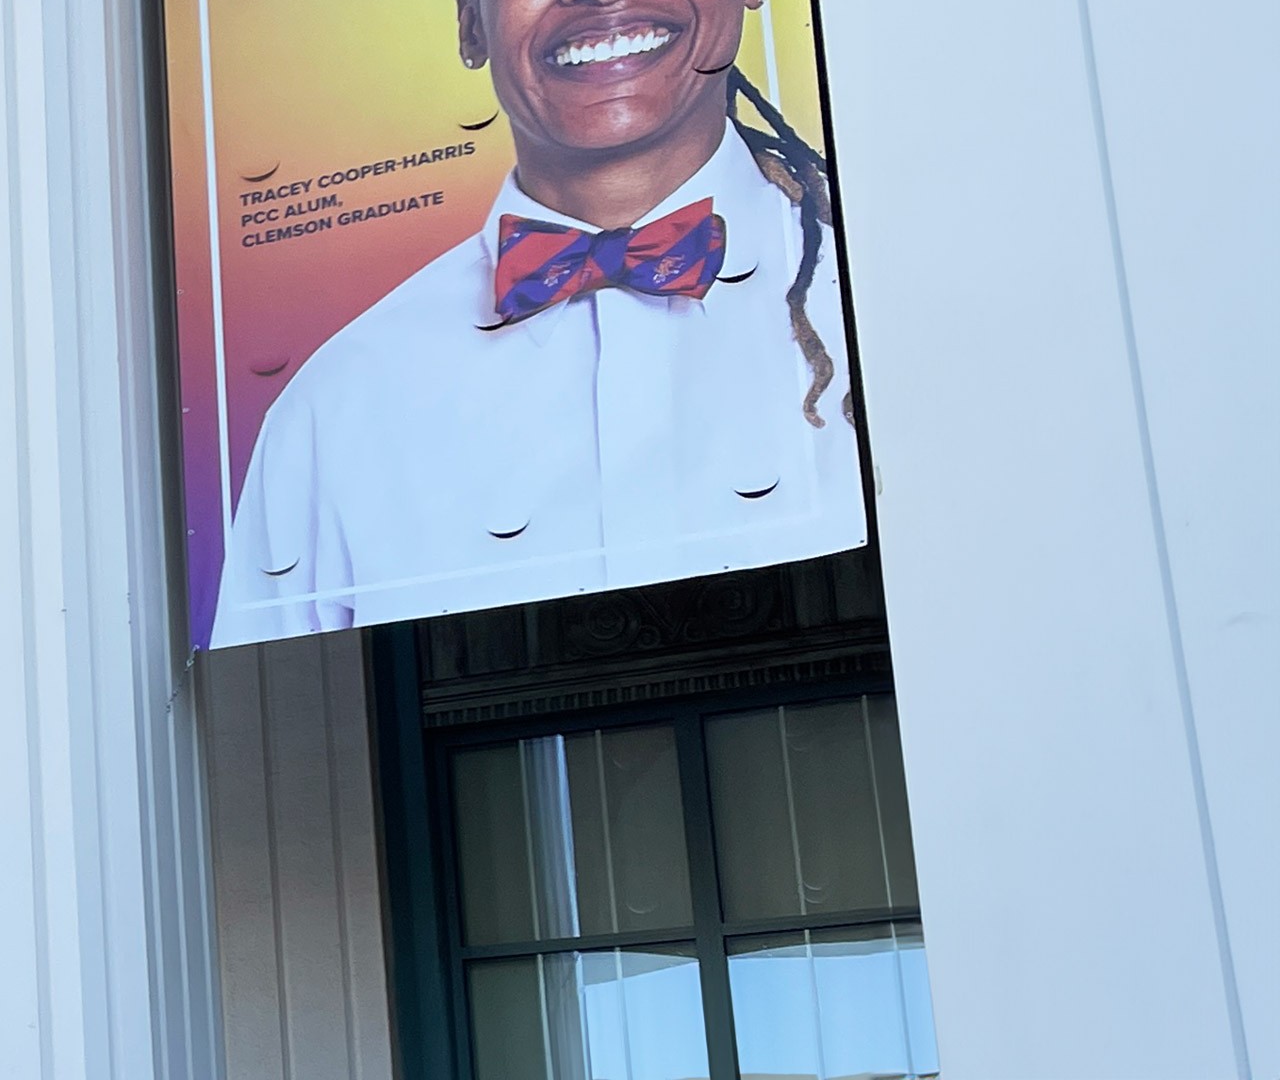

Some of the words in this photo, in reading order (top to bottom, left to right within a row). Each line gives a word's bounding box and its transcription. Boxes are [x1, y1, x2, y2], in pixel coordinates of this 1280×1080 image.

[240, 178, 312, 207] TRACEY
[317, 141, 477, 189] COOPER-HARRIS
[241, 208, 280, 228] PCC
[284, 193, 344, 219] ALUM,
[242, 217, 333, 248] CLEMSON
[336, 191, 445, 227] GRADUATE
